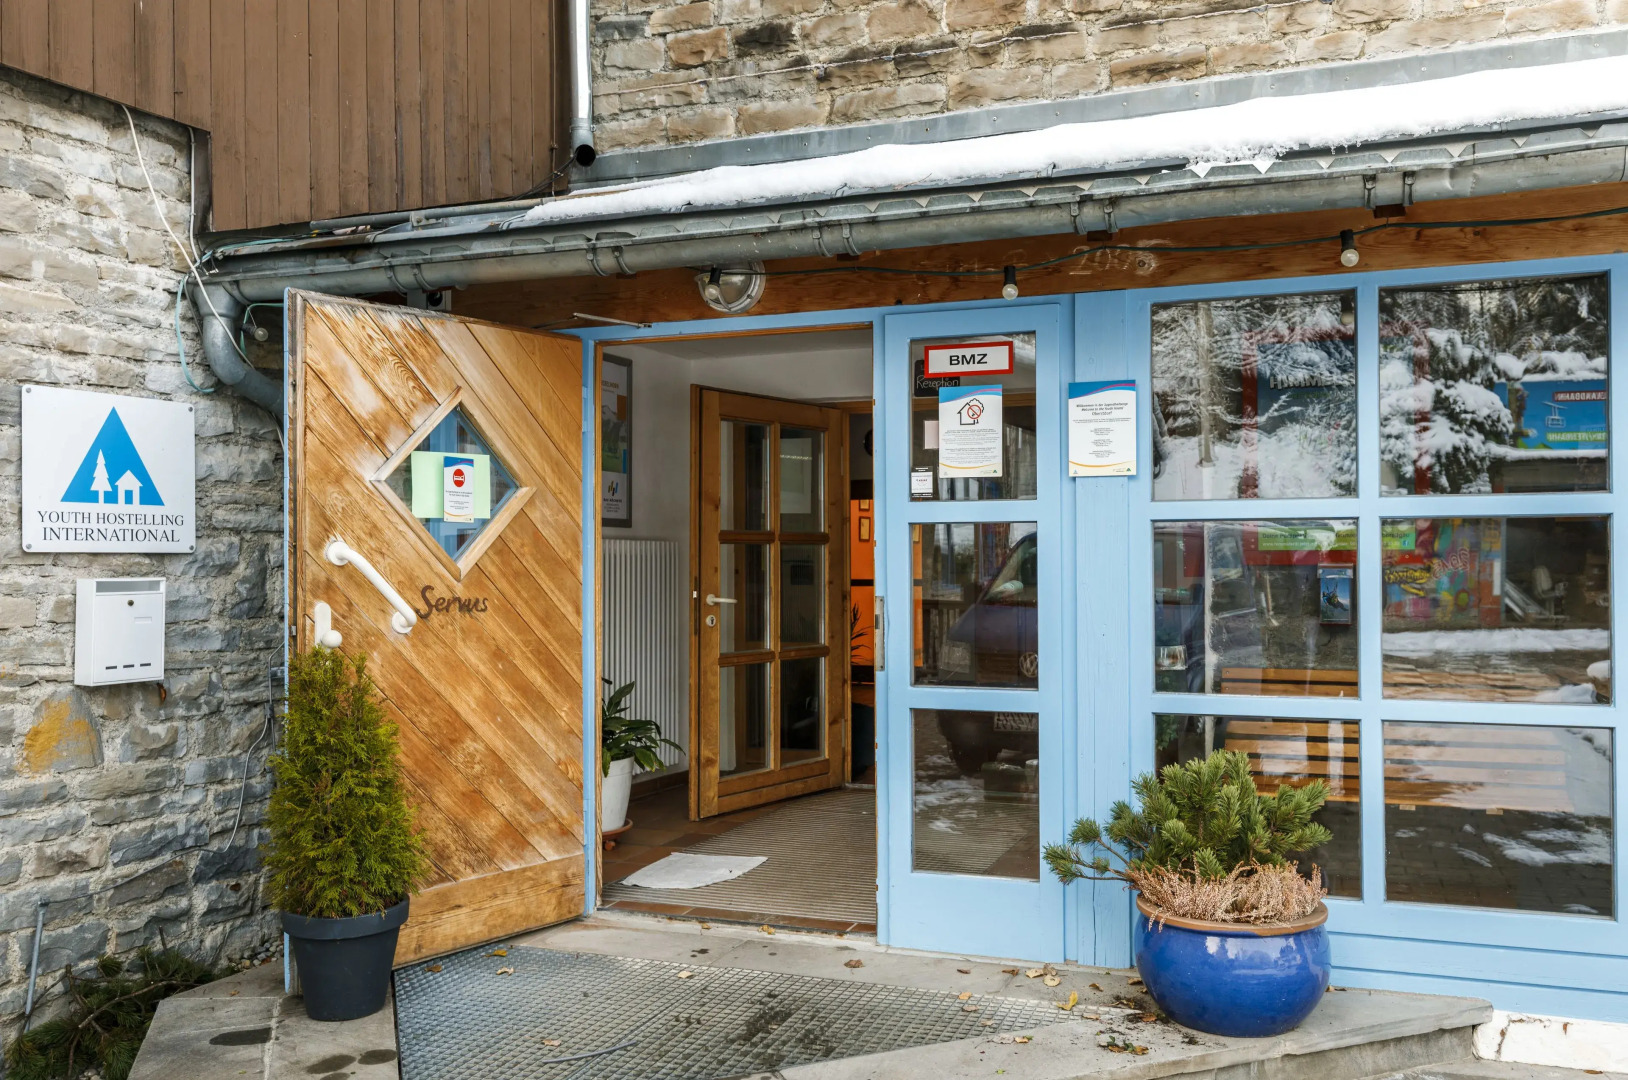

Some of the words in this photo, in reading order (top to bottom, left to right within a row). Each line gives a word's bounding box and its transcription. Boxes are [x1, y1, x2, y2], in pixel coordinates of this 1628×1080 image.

[950, 353, 988, 366] BMZ
[916, 375, 959, 390] Rezeption
[37, 510, 91, 524] YOUTH
[96, 512, 185, 526] HOSTELLING
[43, 527, 180, 542] INTERNATIONAL
[414, 584, 489, 619] Servus
